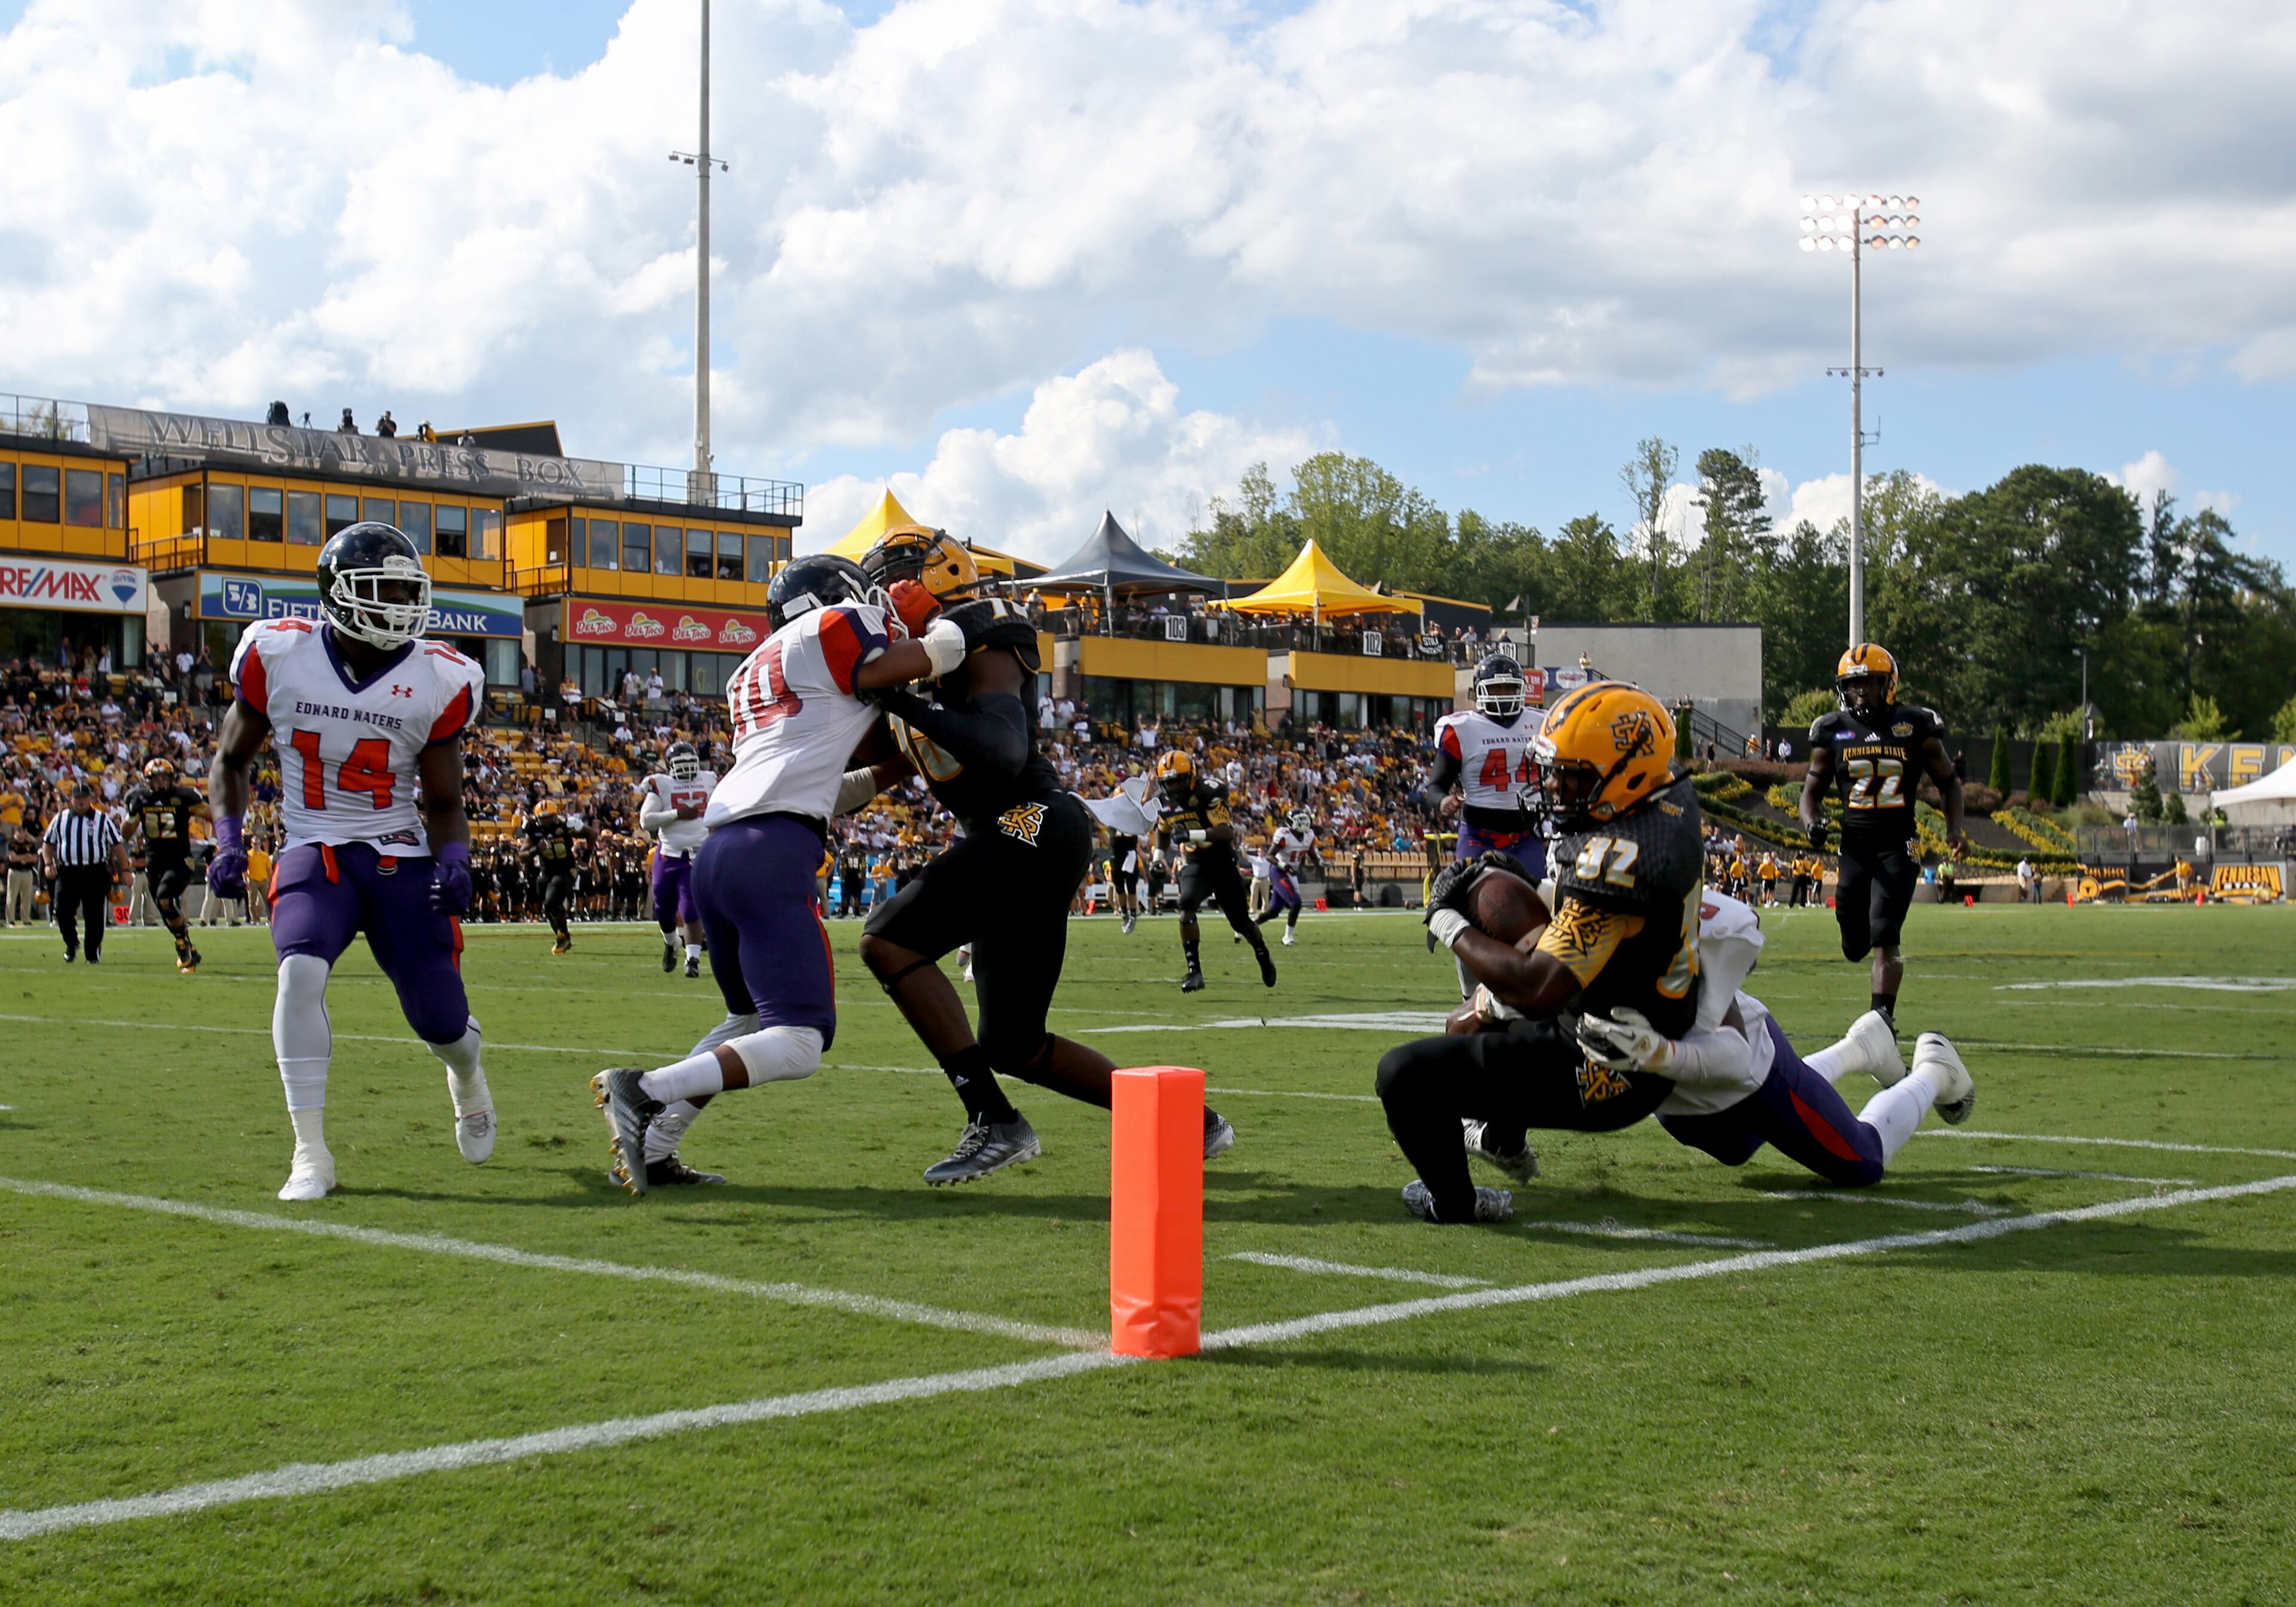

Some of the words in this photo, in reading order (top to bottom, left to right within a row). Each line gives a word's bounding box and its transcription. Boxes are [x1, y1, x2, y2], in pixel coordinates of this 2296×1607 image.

[396, 445, 491, 478] PRESS
[515, 456, 585, 488] BOX
[0, 567, 101, 602] RE/MAX
[576, 621, 596, 634] DEL
[625, 625, 645, 637] DEL
[673, 628, 692, 640] DEL
[719, 631, 737, 643] DEL
[1167, 618, 1184, 638] 103
[1366, 633, 1381, 653] 102
[295, 701, 349, 720] EDWARD
[353, 710, 402, 730] WATERS
[1843, 746, 1881, 762] KENNESAW
[1883, 746, 1908, 761] STATE
[291, 728, 396, 810] 14
[1848, 758, 1906, 809] 22
[1576, 836, 1639, 888] 32
[2210, 865, 2283, 893] KENNESAW
